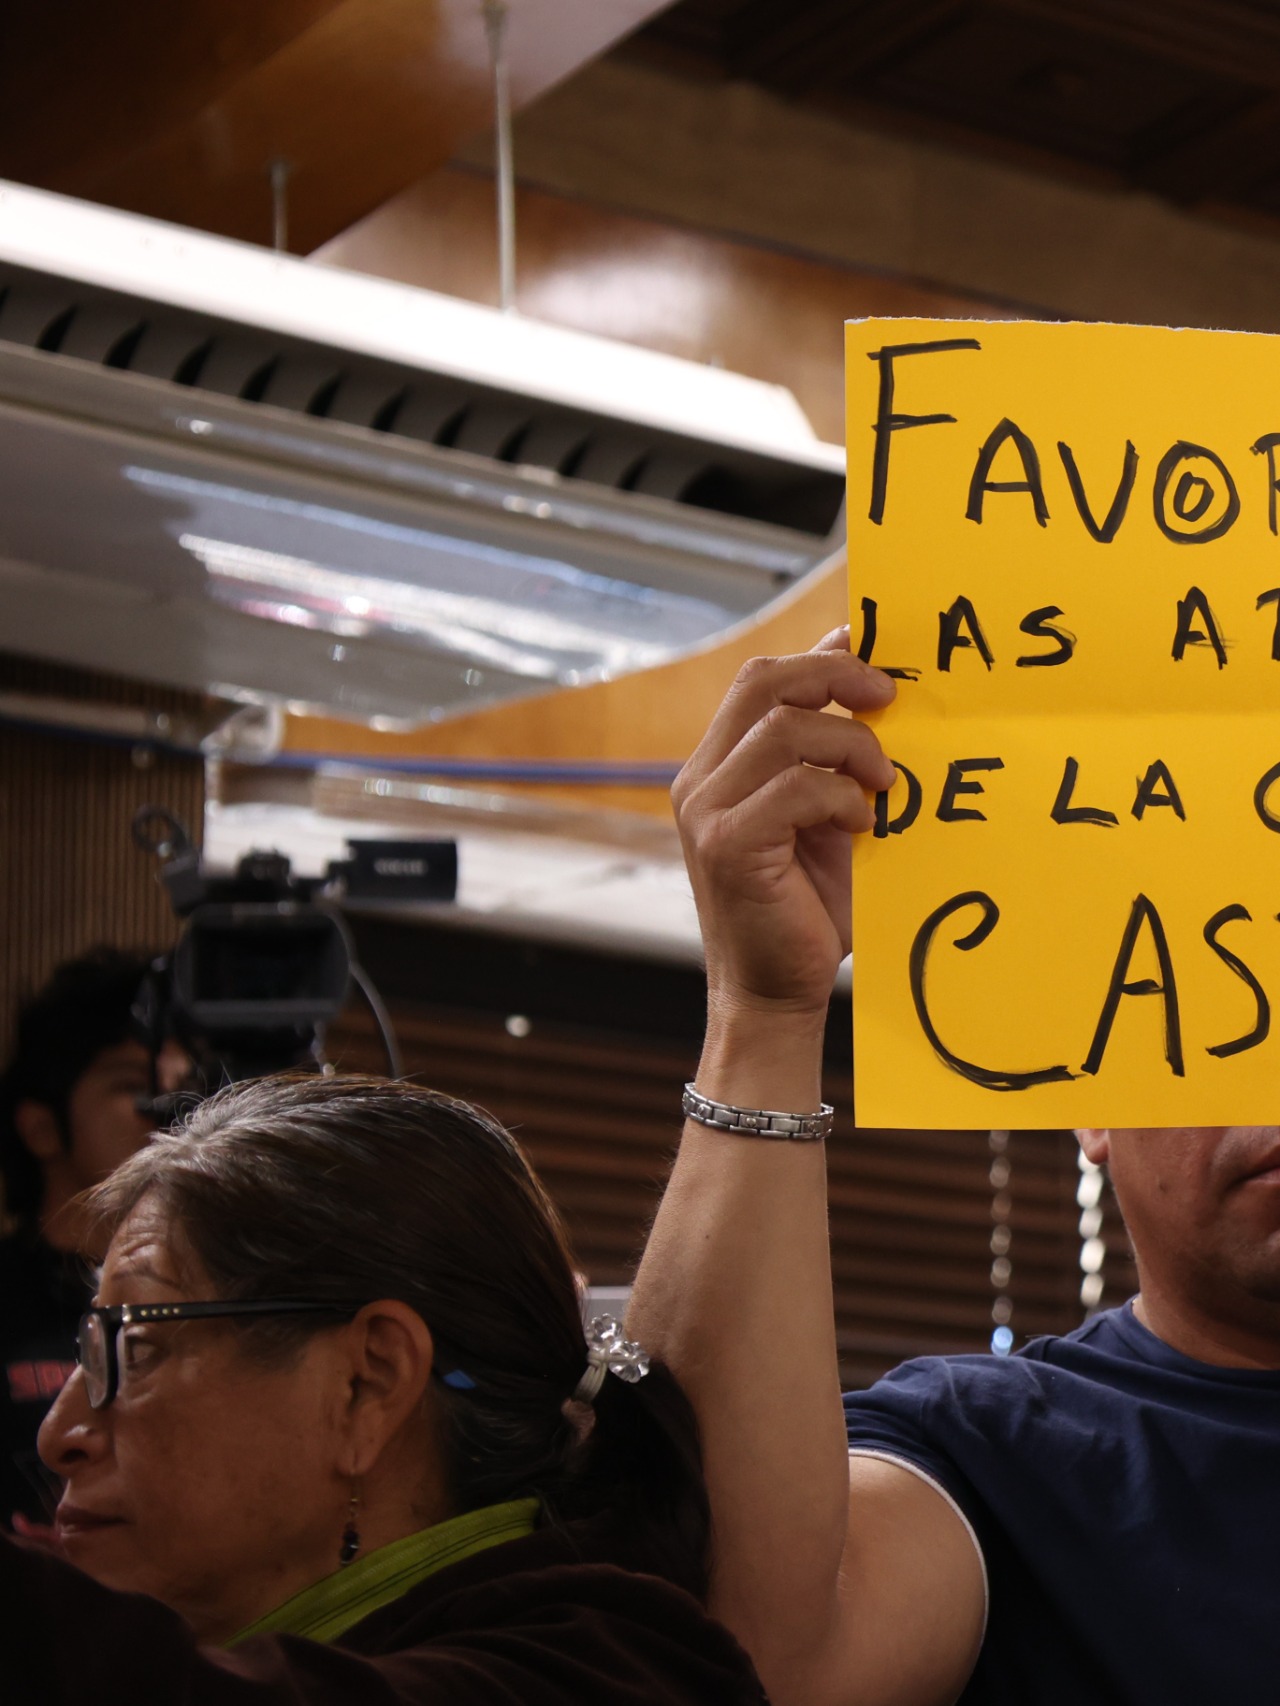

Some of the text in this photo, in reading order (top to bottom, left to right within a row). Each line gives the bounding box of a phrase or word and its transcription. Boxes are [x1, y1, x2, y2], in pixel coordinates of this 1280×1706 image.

[857, 595, 1078, 682] LAS
[873, 756, 1005, 839] DE
[1050, 756, 1187, 829] LA
